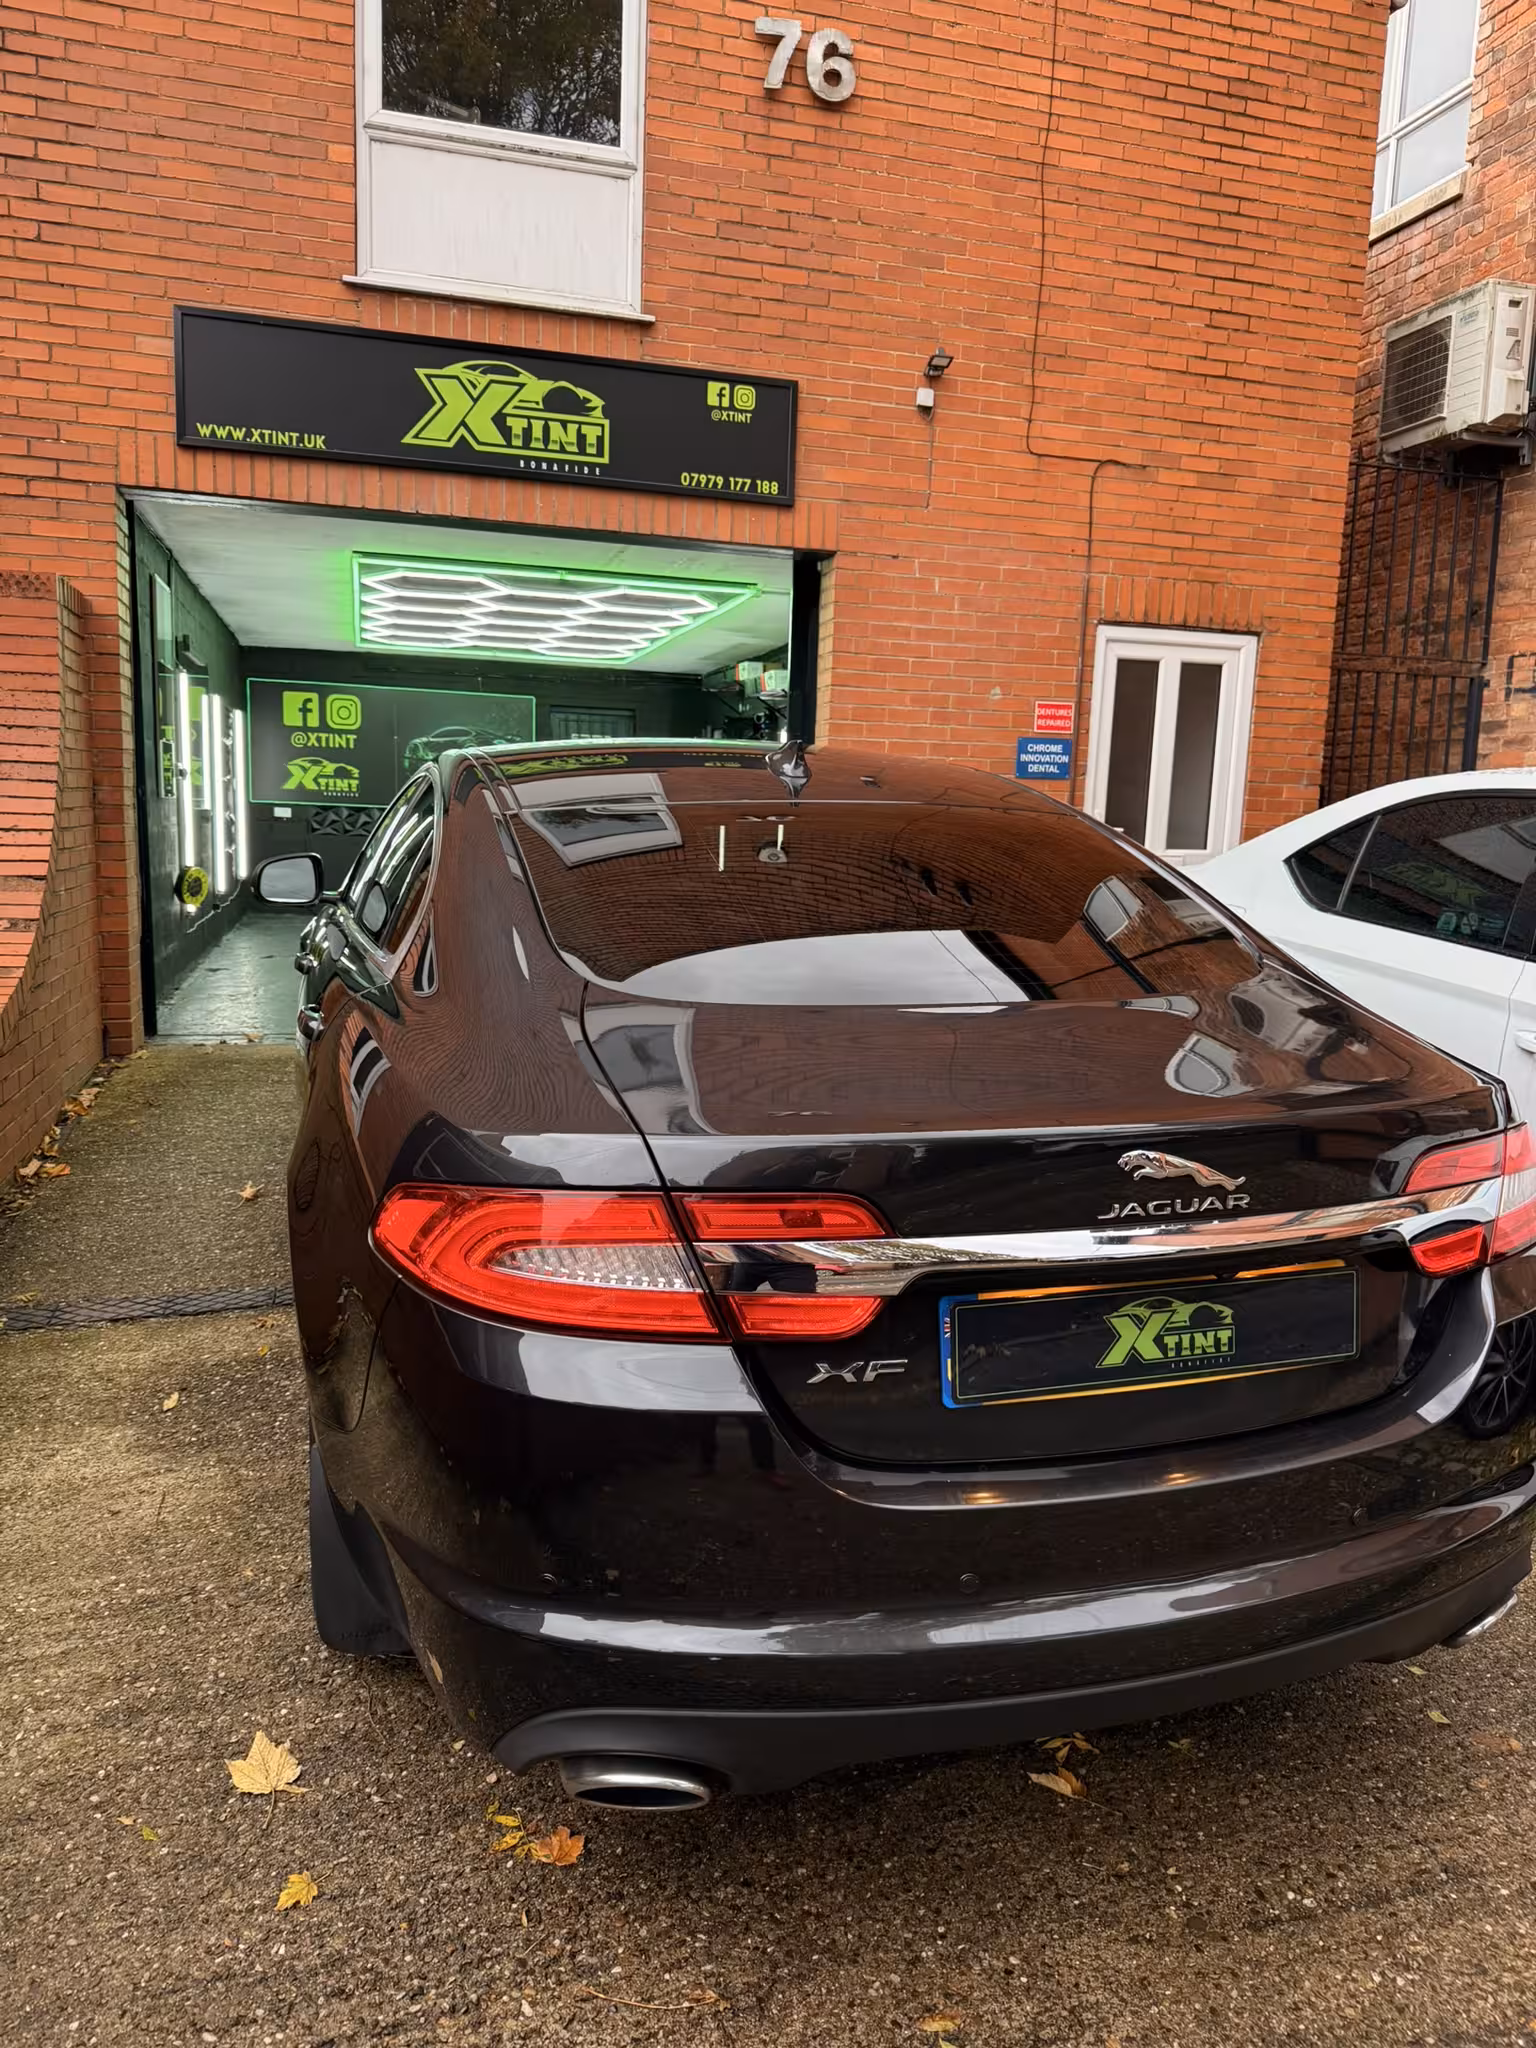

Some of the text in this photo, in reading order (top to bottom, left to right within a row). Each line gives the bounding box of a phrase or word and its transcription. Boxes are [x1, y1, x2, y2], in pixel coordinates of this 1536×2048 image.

[755, 16, 857, 102] 76
[401, 368, 609, 463] XTINT
[711, 409, 752, 424] @XTINT
[196, 422, 326, 449] WWW.XTINT.UK
[519, 459, 600, 476] BONAFIDE
[681, 472, 779, 495] 07979 177 188
[291, 731, 357, 749] @XTINT
[1027, 743, 1063, 753] CHROME
[1020, 753, 1069, 763] INNOVATION
[1028, 763, 1060, 773] DENTAL
[282, 764, 359, 792] XTINT
[1098, 1194, 1250, 1219] JAGUAR
[1096, 1307, 1235, 1368] XTINT
[806, 1359, 908, 1384] XF
